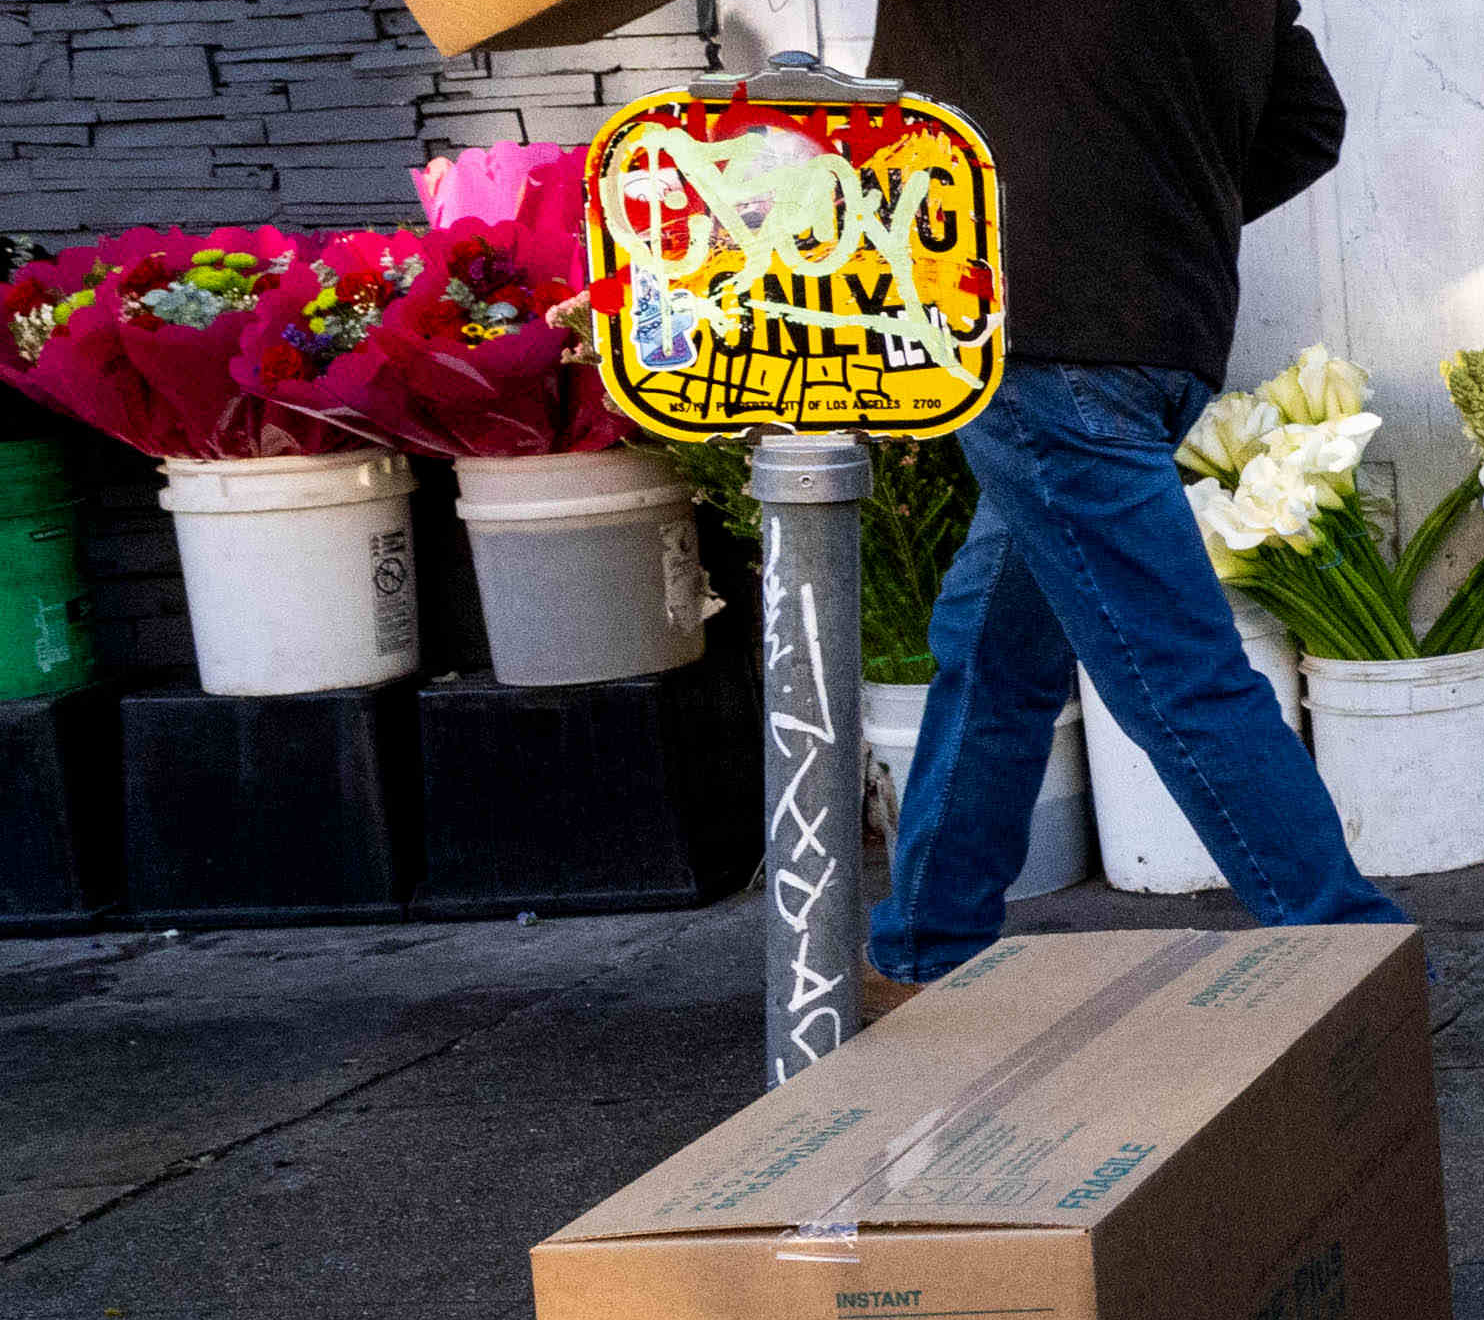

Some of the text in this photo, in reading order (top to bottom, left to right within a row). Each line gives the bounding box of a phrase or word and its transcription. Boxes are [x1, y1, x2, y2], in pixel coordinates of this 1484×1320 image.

[808, 398, 821, 411] OF
[825, 398, 849, 411] LOS
[912, 398, 942, 411] 2700
[1056, 1142, 1157, 1212] FRAGILE
[836, 1289, 922, 1309] INSTANT
